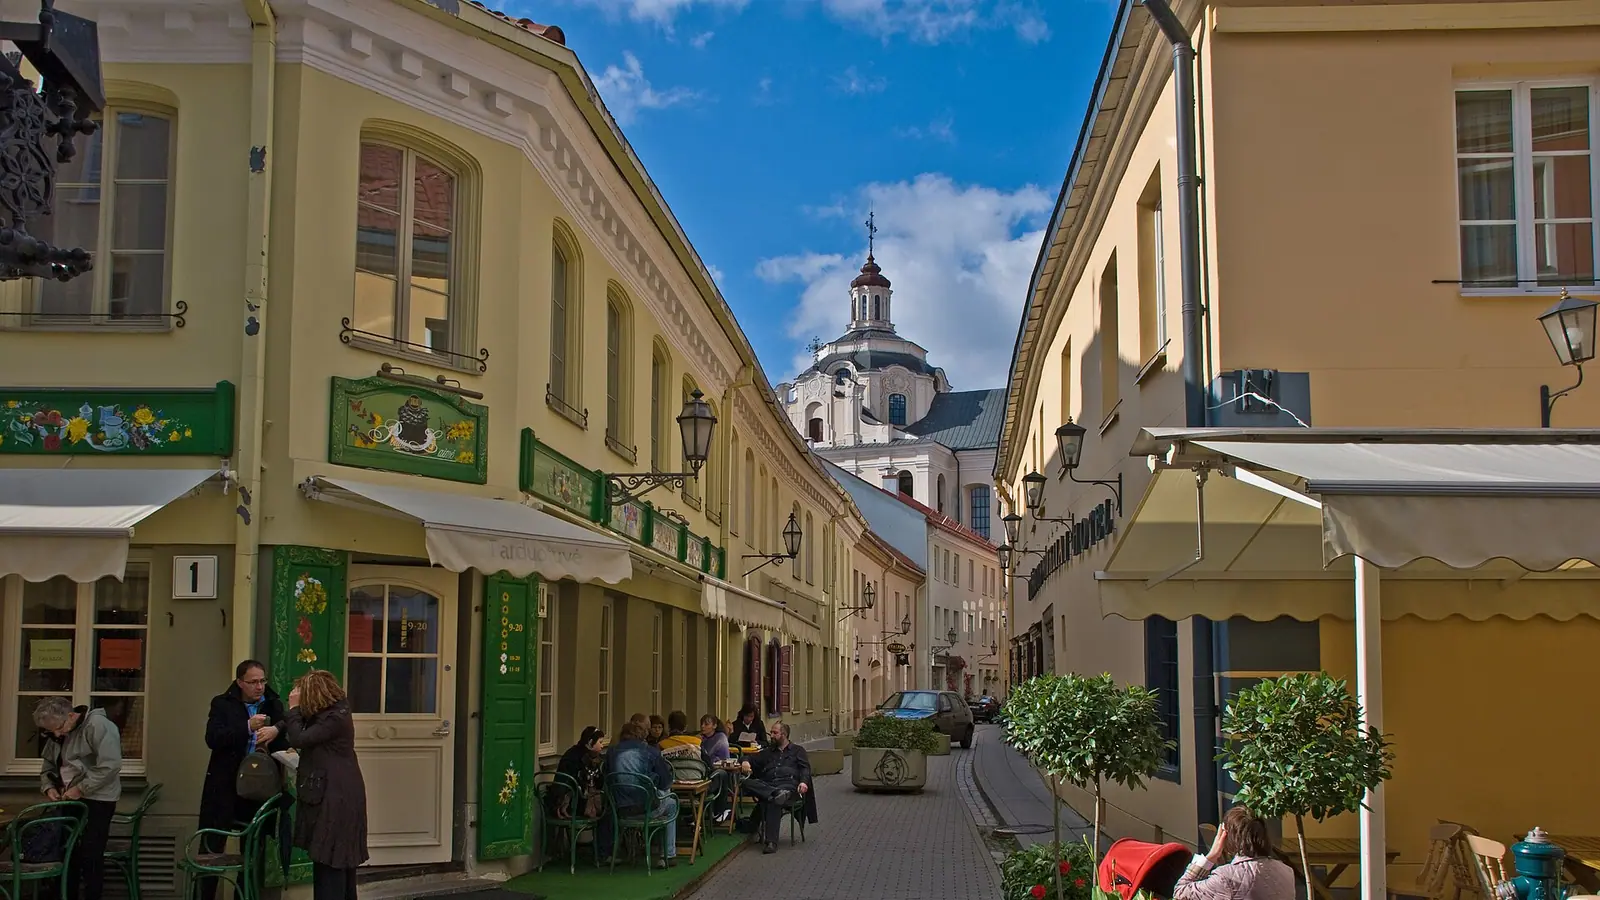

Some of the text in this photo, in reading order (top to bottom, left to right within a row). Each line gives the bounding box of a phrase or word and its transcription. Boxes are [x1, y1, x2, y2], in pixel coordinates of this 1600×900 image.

[1072, 499, 1114, 556] HOTEL
[189, 562, 199, 593] 1
[408, 622, 427, 630] 9-20
[509, 624, 522, 632] 9-20
